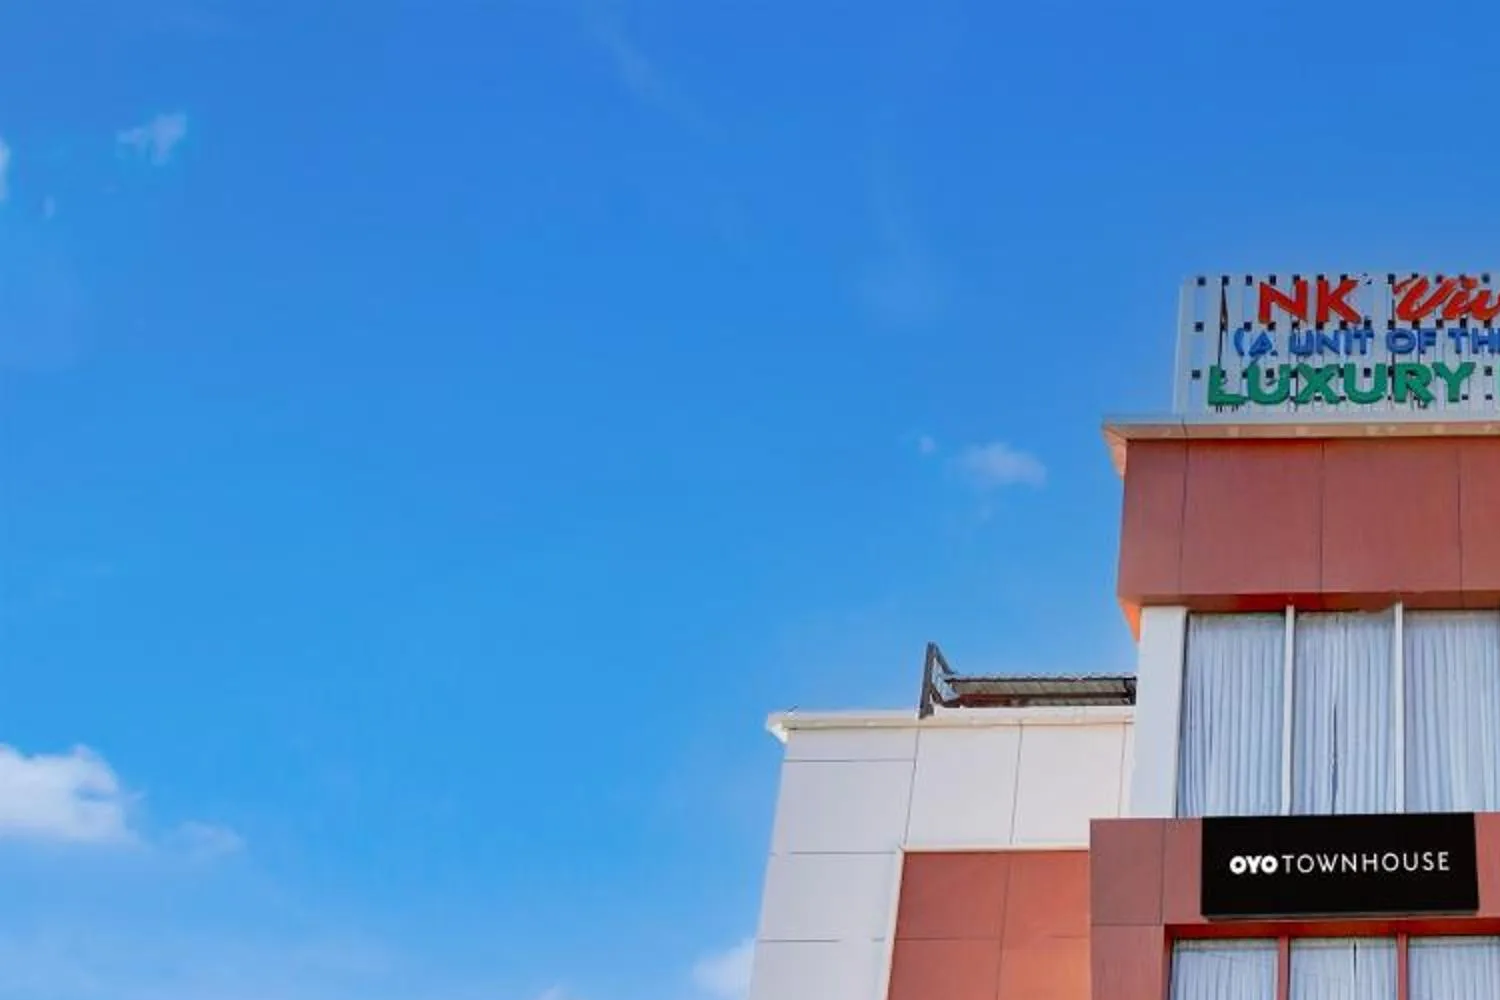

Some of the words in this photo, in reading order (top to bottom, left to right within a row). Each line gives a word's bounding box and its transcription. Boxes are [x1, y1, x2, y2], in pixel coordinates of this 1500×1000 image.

[1258, 278, 1362, 324] NK
[1288, 326, 1375, 355] UNIT
[1386, 327, 1438, 355] OF
[1207, 361, 1476, 406] LUXURY
[1229, 855, 1278, 875] OYO
[1282, 851, 1450, 874] TOWNHOUSE
